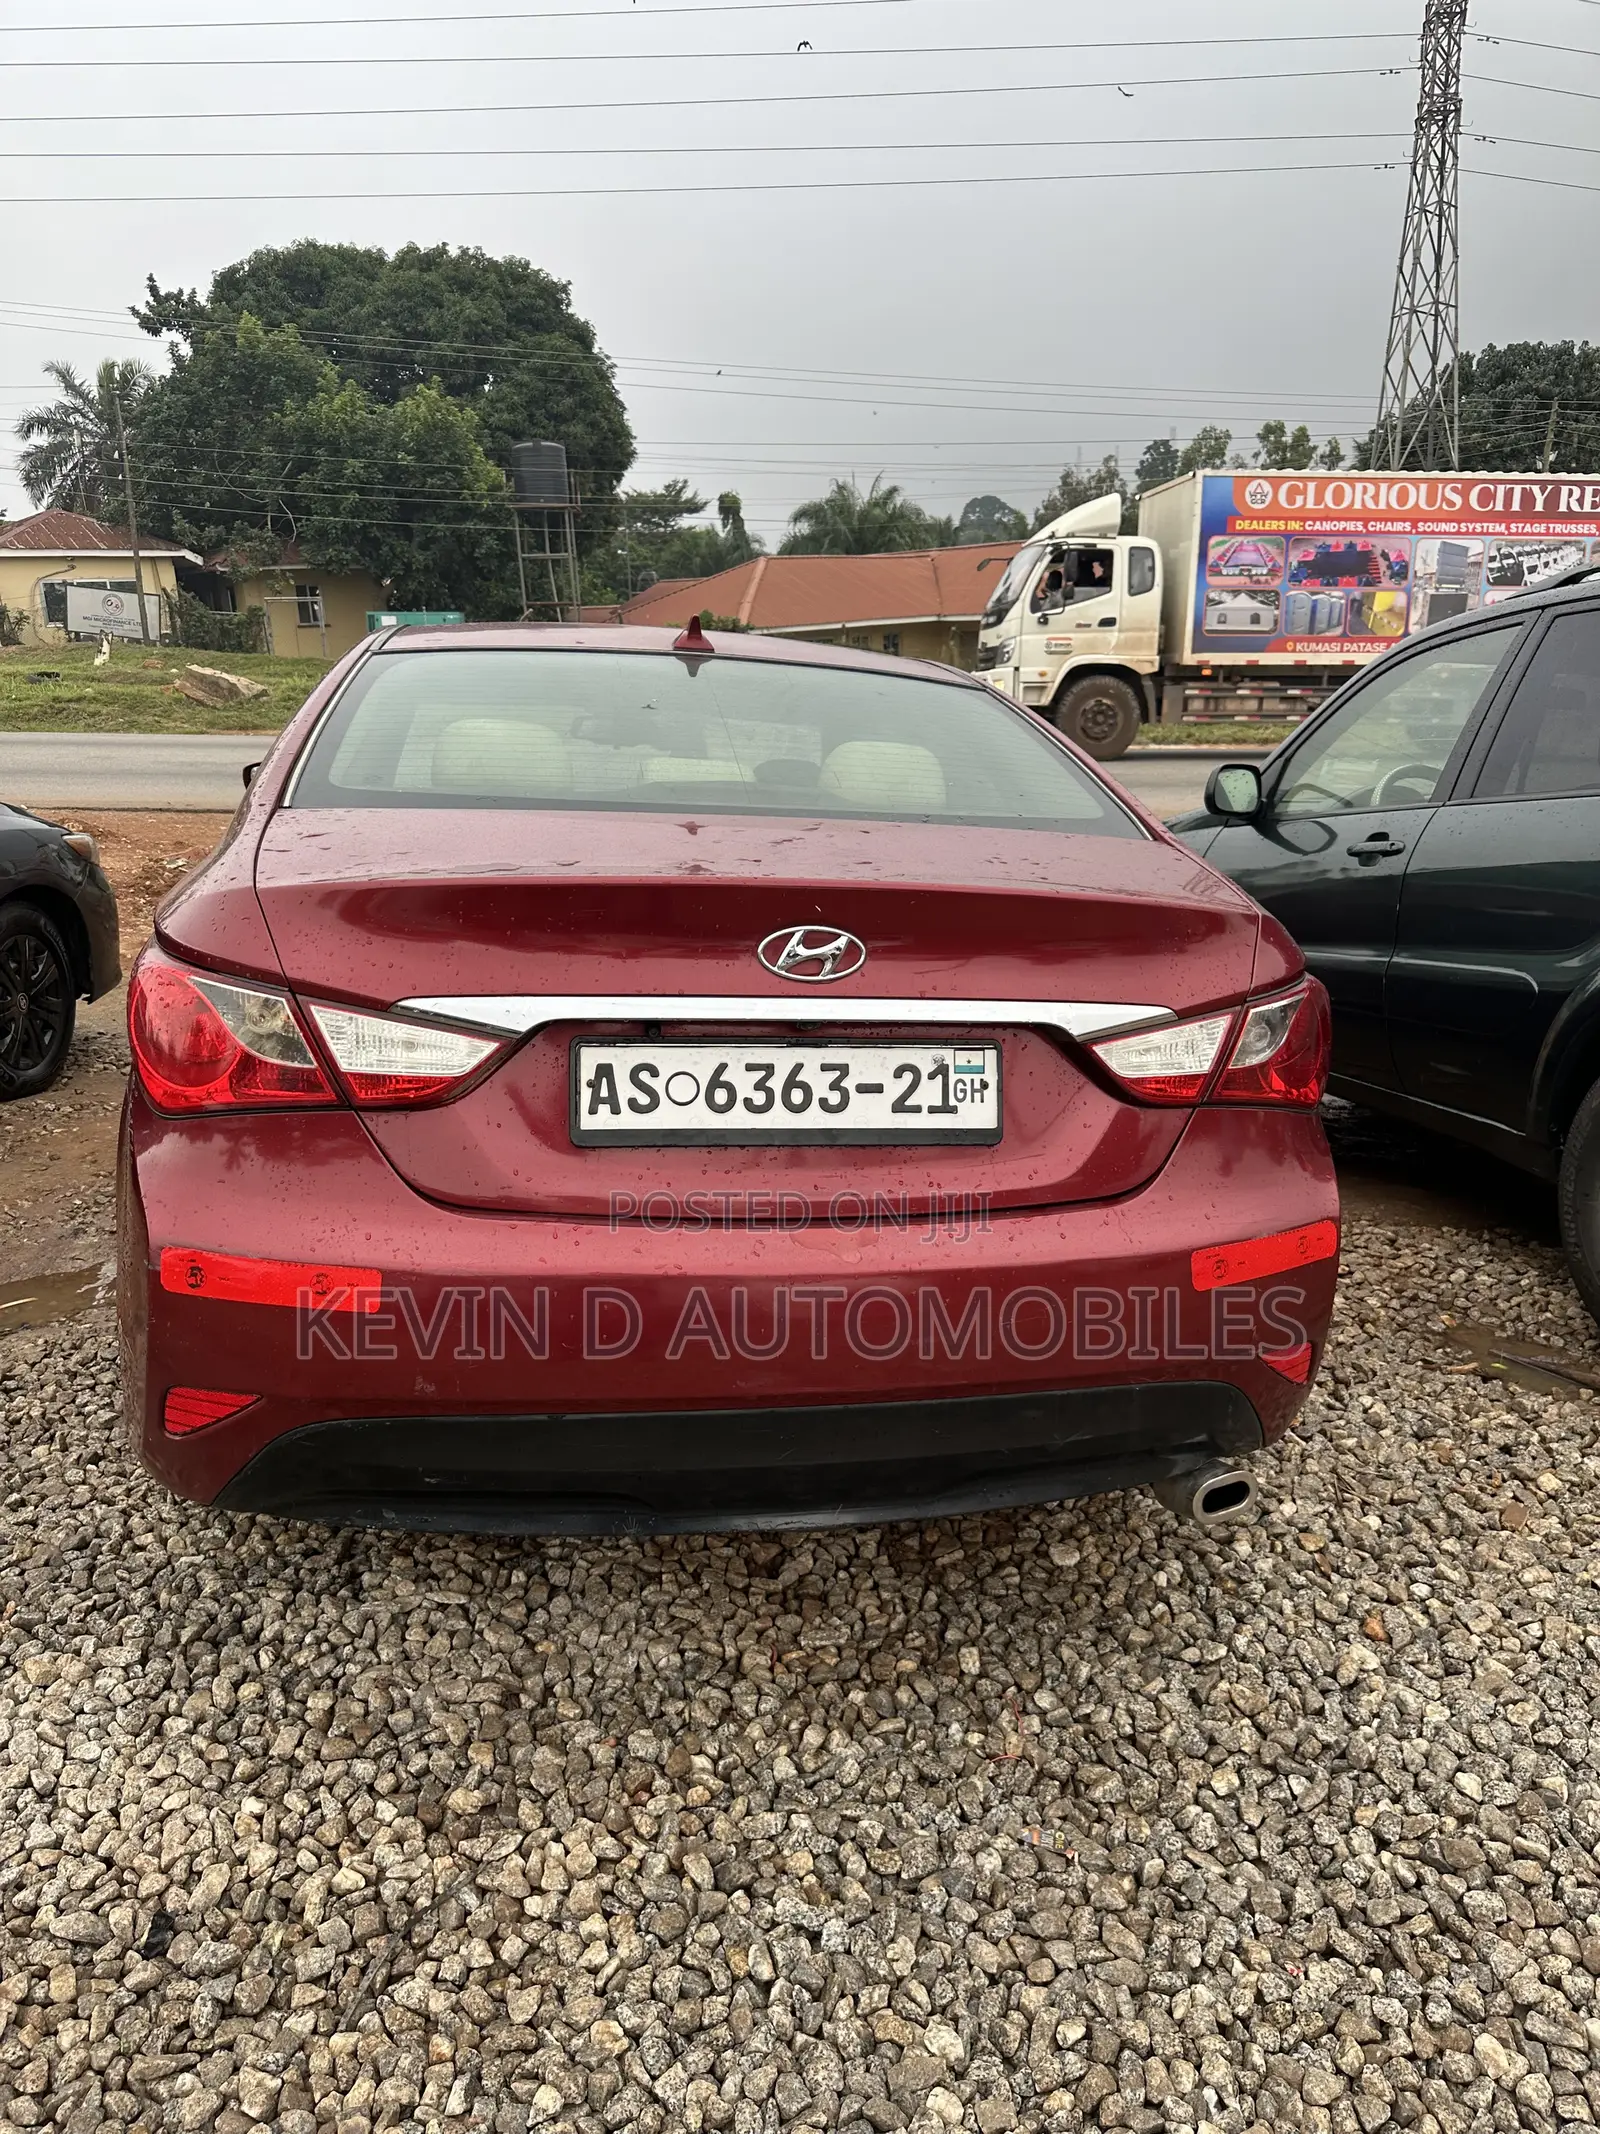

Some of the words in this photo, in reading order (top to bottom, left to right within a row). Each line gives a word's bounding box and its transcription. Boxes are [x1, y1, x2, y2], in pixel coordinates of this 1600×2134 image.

[1277, 481, 1462, 511] GLORIOUS
[1469, 484, 1555, 512] CITY
[1556, 485, 1600, 512] RE
[1235, 520, 1285, 531] DEALERS
[1287, 520, 1304, 531] IN:
[1304, 521, 1366, 533] CANOPIES,
[1417, 522, 1458, 532] SOUND
[1460, 523, 1508, 535] SYSTEM,
[1509, 523, 1547, 533] STAGE
[1548, 523, 1599, 535] TRUSSES,
[93, 616, 132, 626] MICROFINANCE
[1296, 642, 1341, 652] KUMASI
[1343, 642, 1388, 652] PATASE
[587, 1062, 661, 1115] AS
[704, 1062, 958, 1115] 6363-21
[953, 1078, 985, 1103] GH
